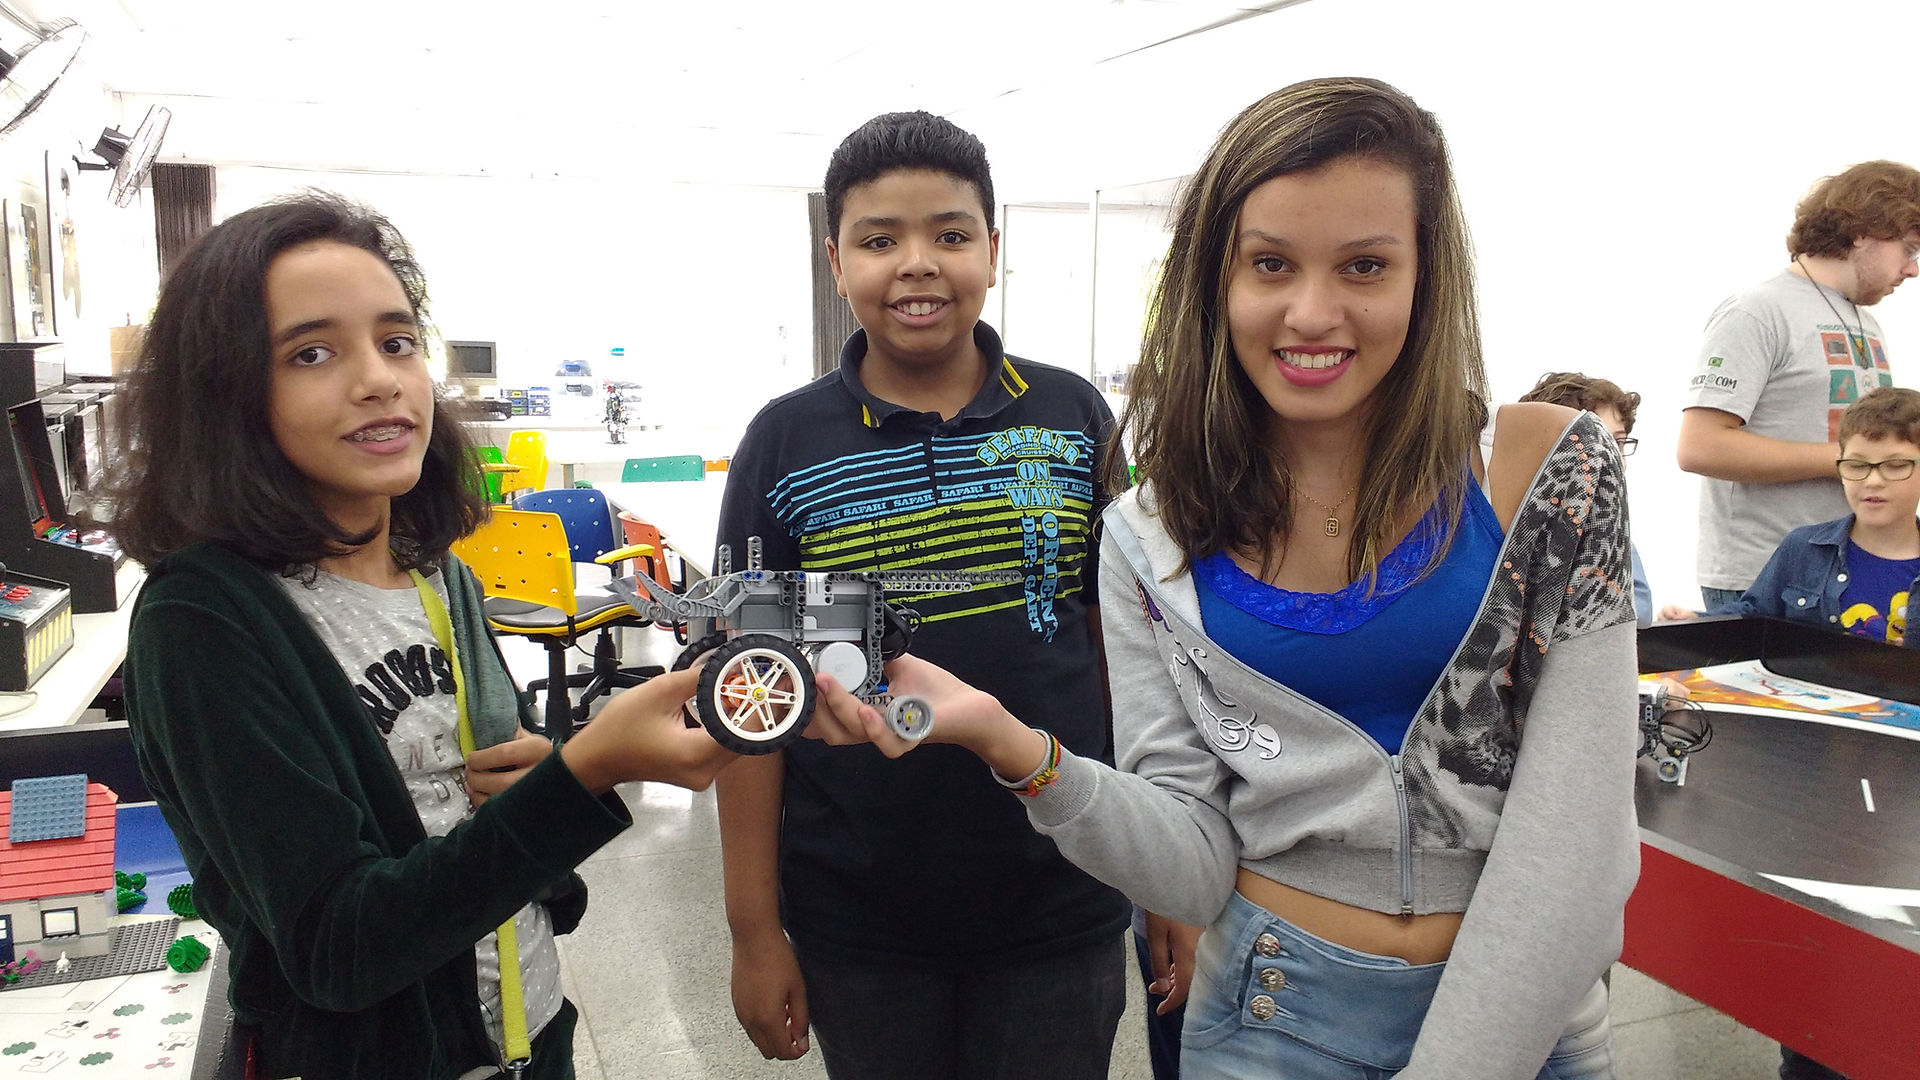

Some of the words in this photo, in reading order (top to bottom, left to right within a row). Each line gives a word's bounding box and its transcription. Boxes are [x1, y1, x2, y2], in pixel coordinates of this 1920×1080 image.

[978, 426, 1080, 465] SEAFAIR
[1018, 461, 1049, 481] ON
[806, 511, 841, 527] AFARI
[843, 502, 887, 516] SAFARI
[941, 485, 984, 498] SAFARI
[1006, 487, 1064, 509] WAYS
[1021, 516, 1038, 569] DEP:
[1024, 574, 1043, 632] GART
